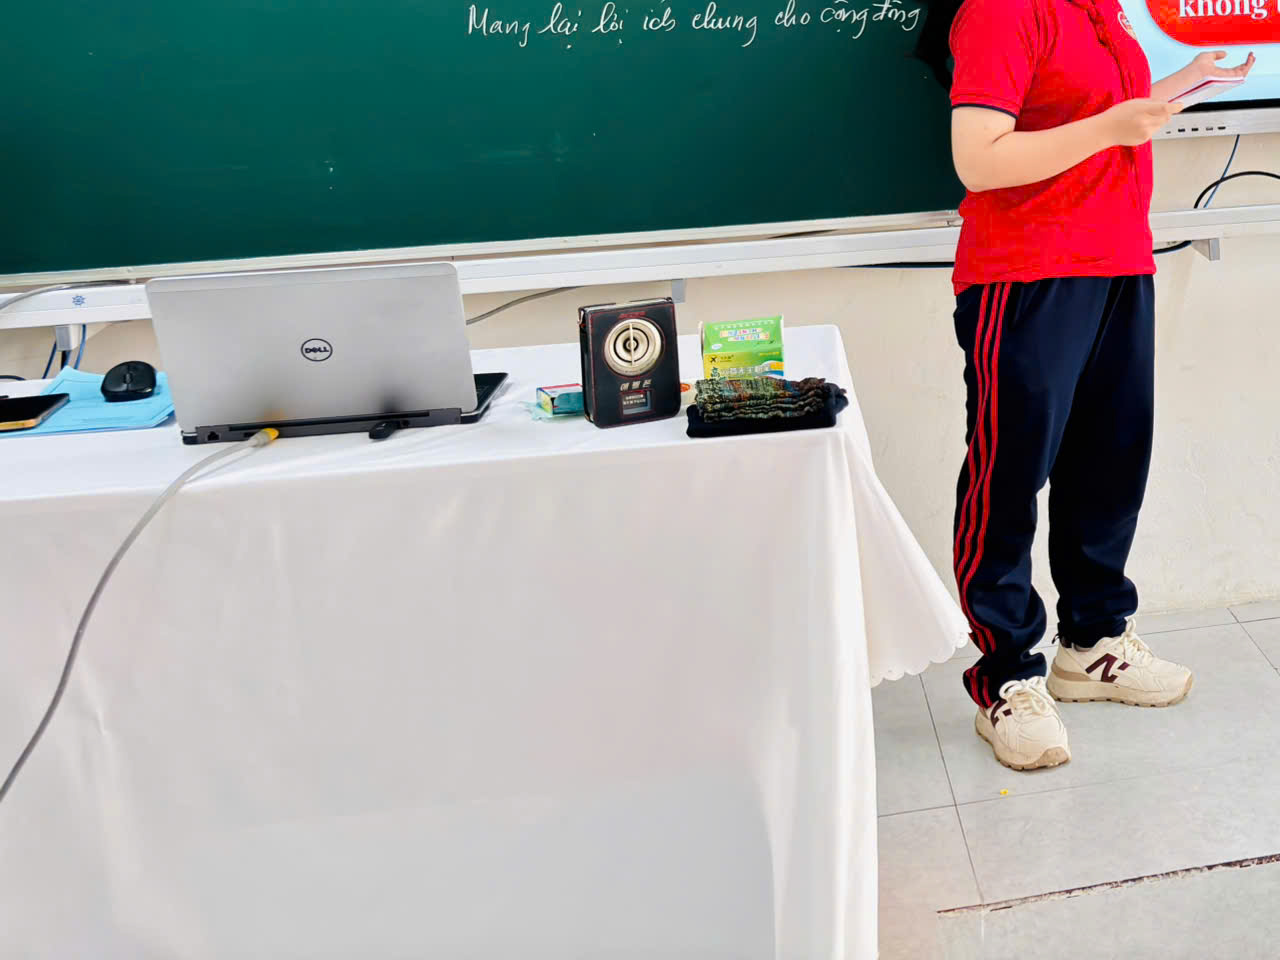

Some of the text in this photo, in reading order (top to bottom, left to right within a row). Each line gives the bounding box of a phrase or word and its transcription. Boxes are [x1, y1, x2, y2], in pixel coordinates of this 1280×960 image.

[468, 4, 530, 48] Mang
[537, 2, 582, 49] lại
[592, 1, 629, 44] lợi
[691, 1, 758, 48] chung
[820, 0, 870, 40] cộng
[304, 346, 330, 354] DELL
